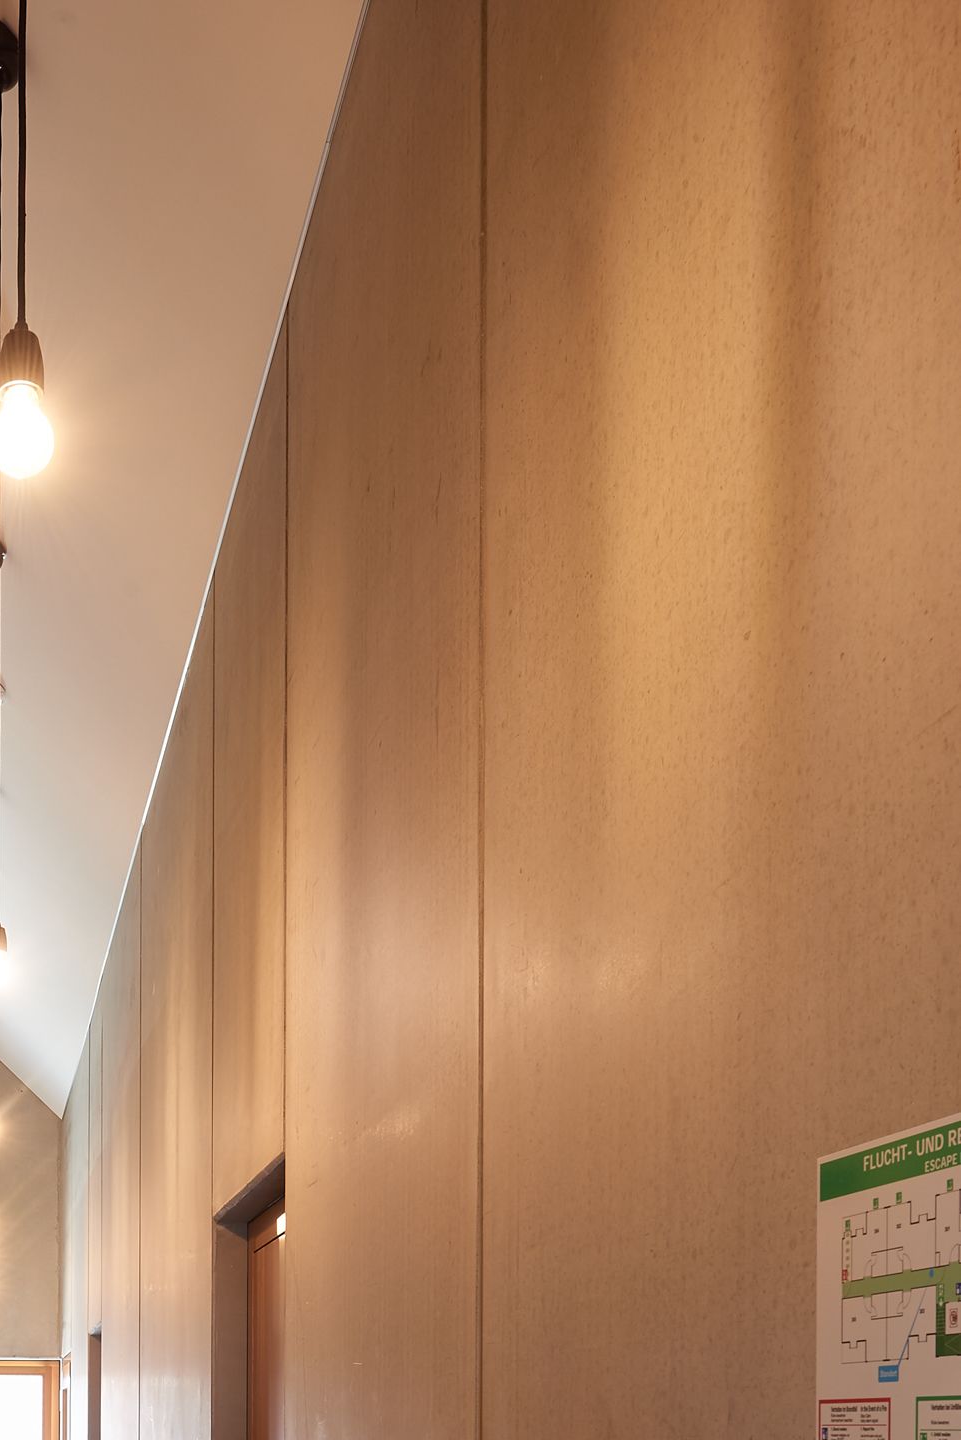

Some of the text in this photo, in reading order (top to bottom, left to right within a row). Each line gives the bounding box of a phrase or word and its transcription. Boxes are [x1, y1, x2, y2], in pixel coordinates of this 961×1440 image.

[863, 1144, 913, 1172] FLUCHT-
[916, 1133, 944, 1157] UND
[925, 1153, 959, 1172] ESCAPE
